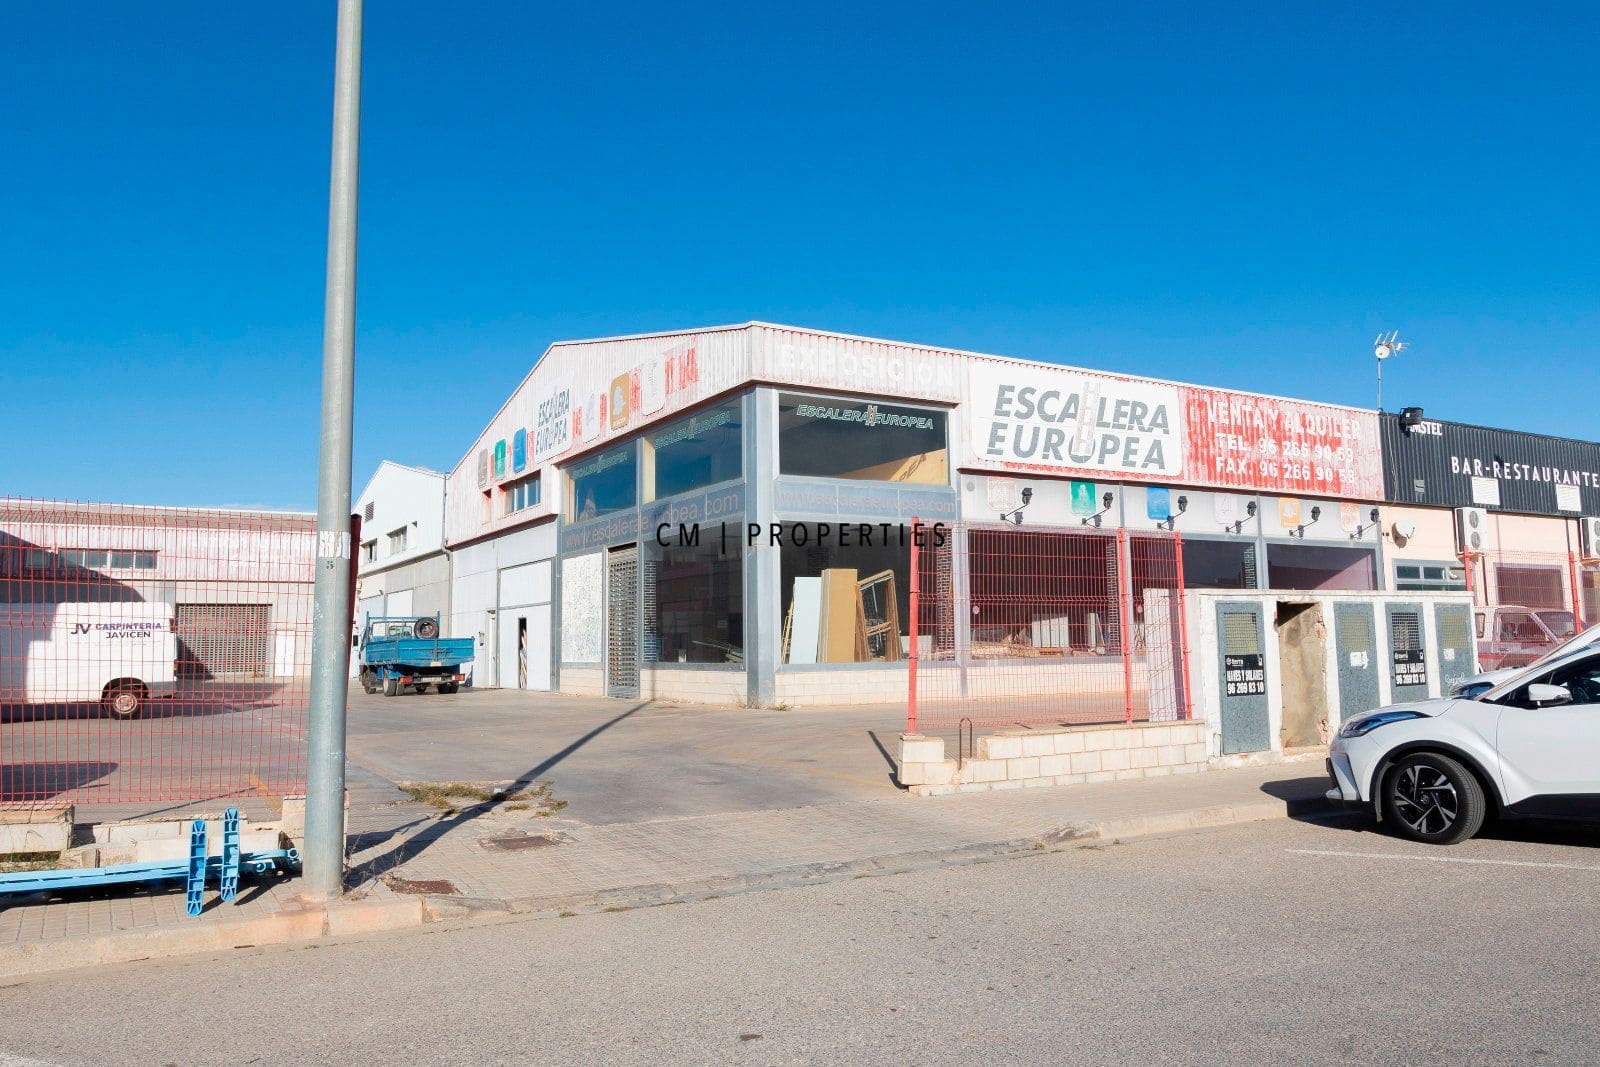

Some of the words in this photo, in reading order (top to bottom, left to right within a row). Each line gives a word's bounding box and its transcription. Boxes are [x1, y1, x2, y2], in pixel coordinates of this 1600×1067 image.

[796, 404, 868, 422] ESCALERA
[873, 413, 934, 430] EUROPEA
[994, 384, 1170, 435] ESCALERA
[1206, 395, 1264, 429] VENTA
[1284, 409, 1361, 440] ALQUILER
[986, 421, 1166, 470] EUROPEA
[1258, 437, 1277, 454] 96
[1283, 440, 1309, 458] 266
[1259, 461, 1278, 478] 96
[1284, 463, 1311, 481] 266
[1316, 467, 1334, 483] 90
[1451, 456, 1600, 488] BAR-RESTAURANTE
[71, 623, 92, 635] JV
[95, 622, 162, 631] CARPINTERIA
[106, 631, 151, 639] JAVICEN
